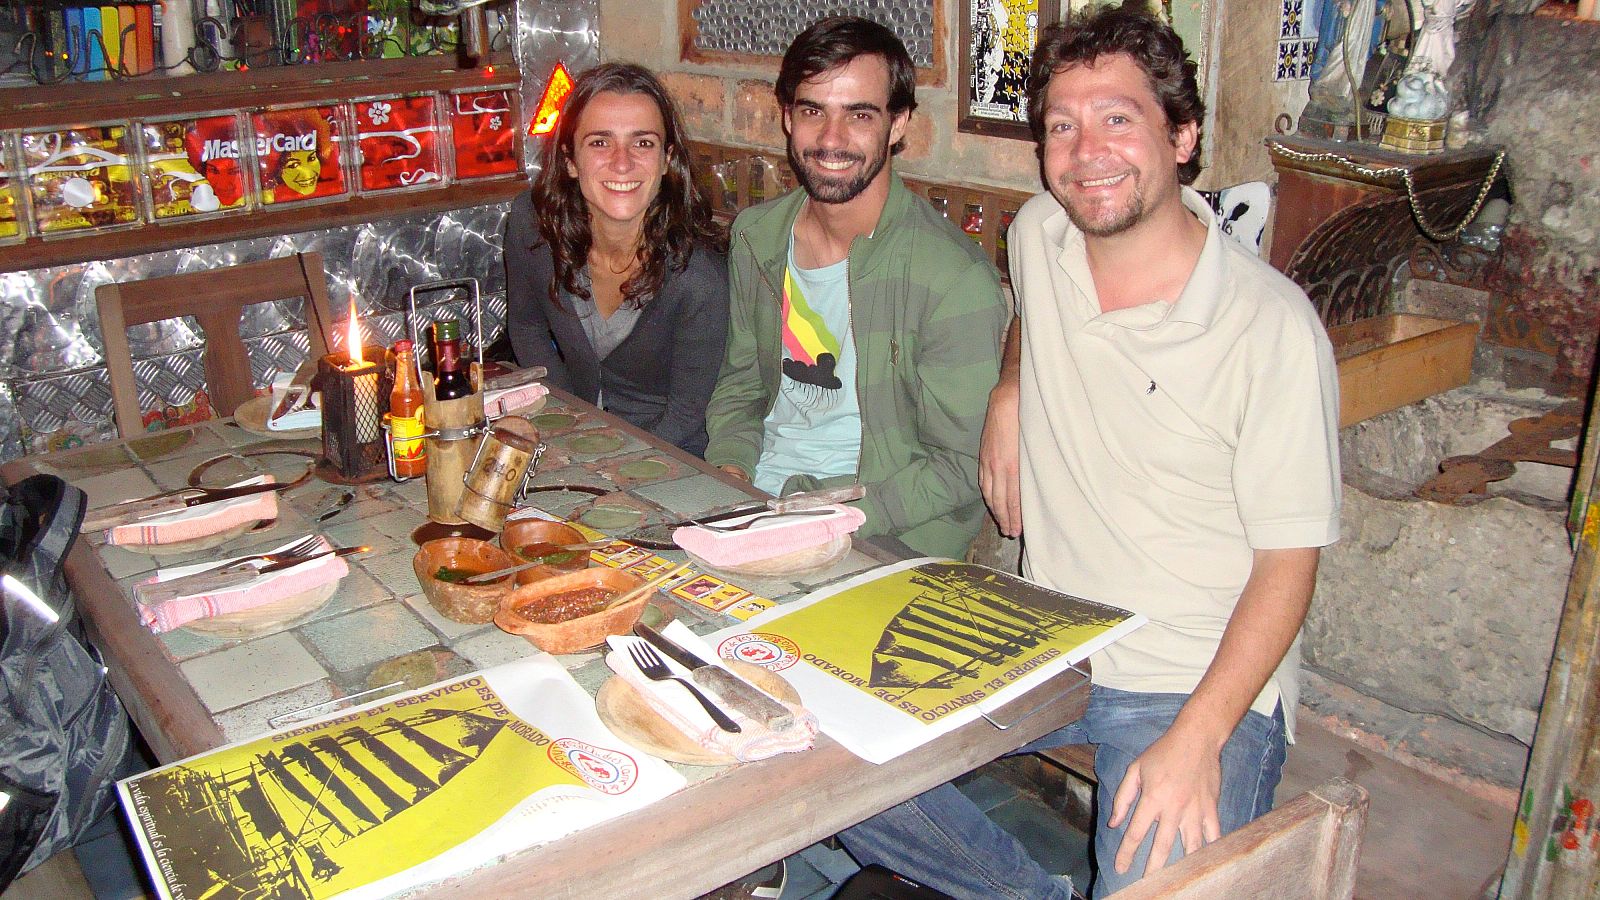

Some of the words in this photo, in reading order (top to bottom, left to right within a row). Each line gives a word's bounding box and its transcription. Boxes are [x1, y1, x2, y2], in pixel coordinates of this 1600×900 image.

[201, 129, 318, 162] MaserCard
[803, 653, 869, 687] MORADO
[1009, 648, 1061, 681] SIEMPRE
[874, 688, 900, 703] DE
[984, 678, 1006, 691] EL
[271, 712, 361, 743] SIEMPRE
[367, 706, 391, 718] EL
[395, 678, 482, 708] SERVICIO
[477, 686, 495, 702] ES
[489, 702, 509, 717] DE
[507, 720, 551, 747] MORADO
[898, 701, 921, 715] ES
[922, 689, 986, 721] SERVICIO
[132, 786, 151, 805] vida
[138, 804, 167, 840] espiritual
[152, 839, 164, 849] es
[156, 847, 172, 858] la
[160, 857, 181, 885] ciencia
